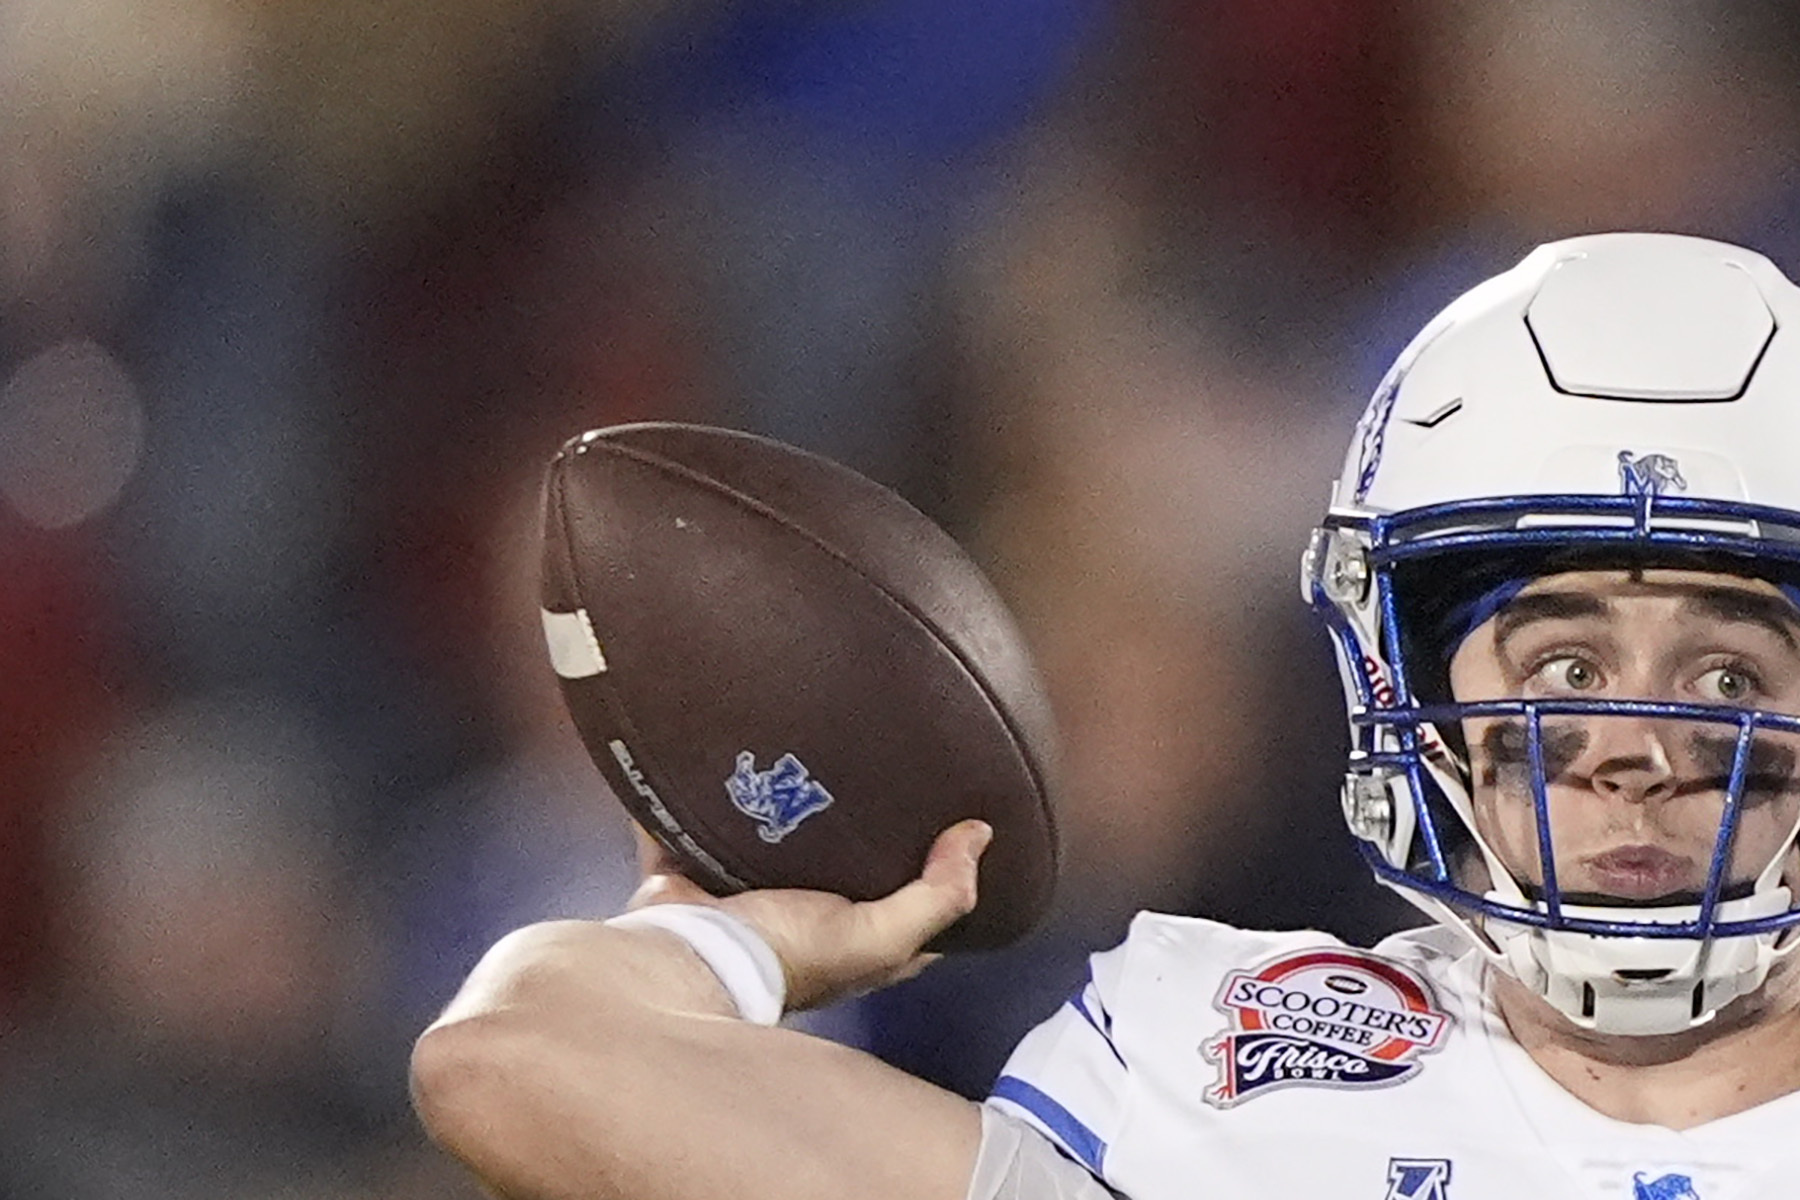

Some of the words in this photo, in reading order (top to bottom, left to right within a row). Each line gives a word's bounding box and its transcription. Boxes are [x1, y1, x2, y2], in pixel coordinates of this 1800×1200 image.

[1234, 982, 1432, 1040] SCOOTER'S
[1272, 1014, 1374, 1047] COFFEE
[1237, 1038, 1370, 1082] Frisco
[1273, 1066, 1344, 1080] BOWL
